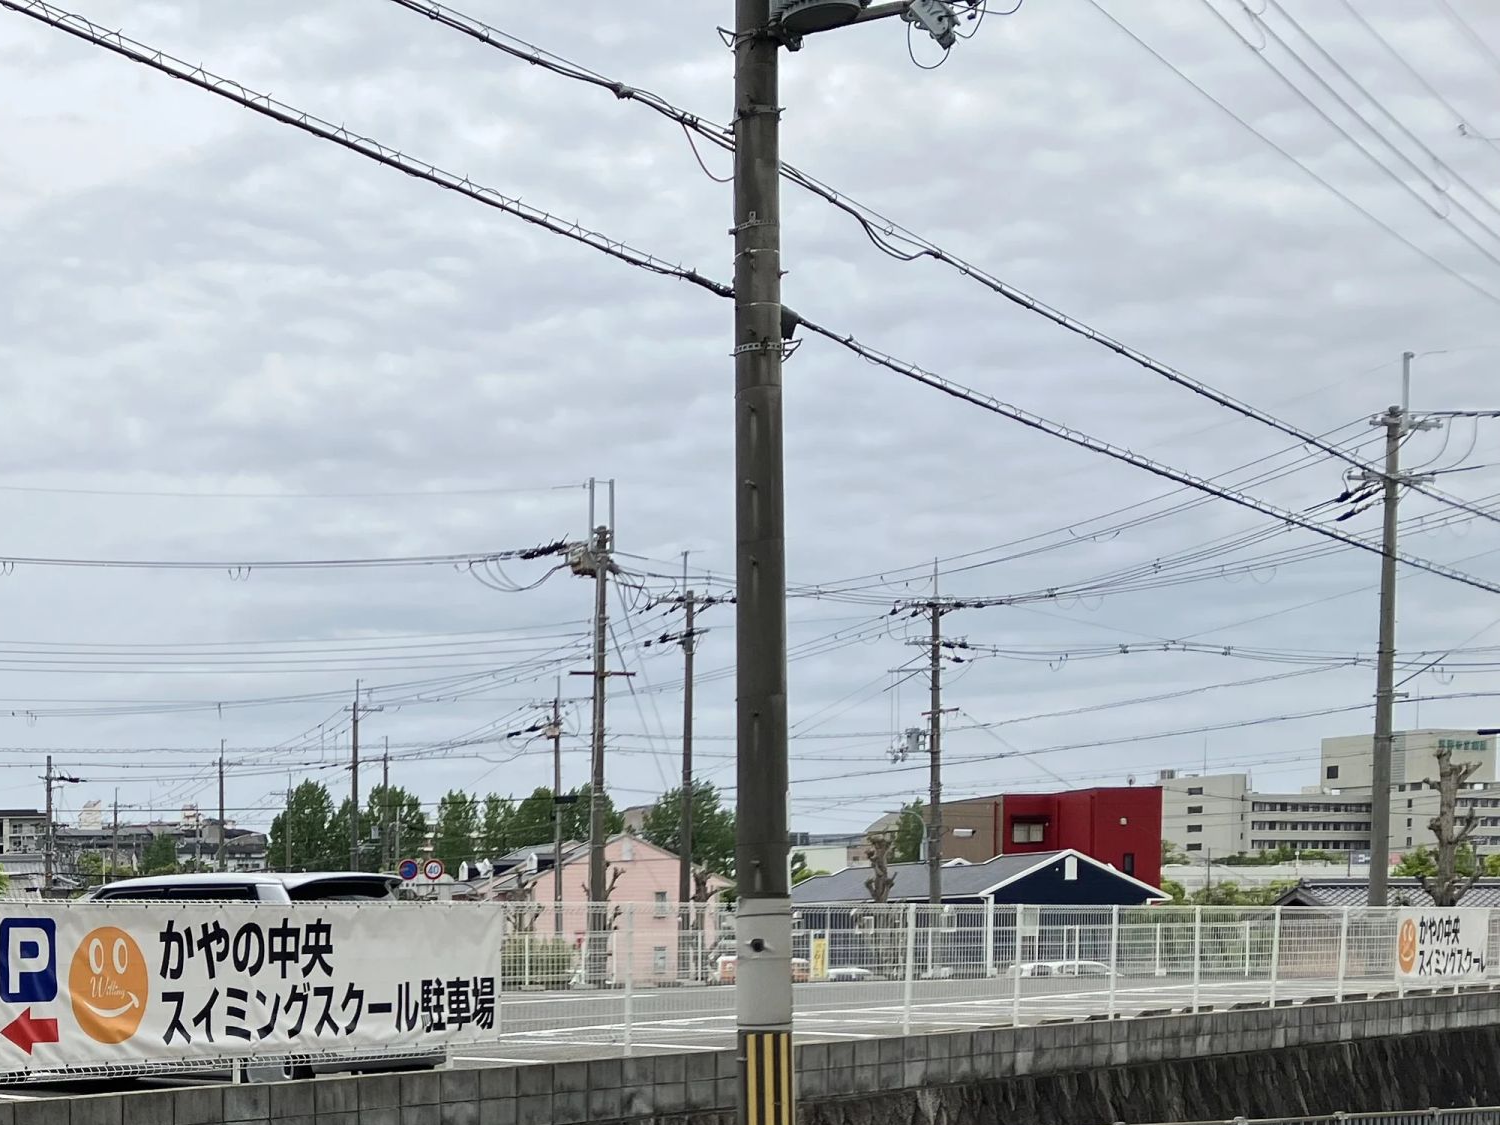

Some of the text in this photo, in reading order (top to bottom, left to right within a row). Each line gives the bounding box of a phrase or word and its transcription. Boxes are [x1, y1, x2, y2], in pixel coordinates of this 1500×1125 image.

[8, 926, 51, 995] P
[159, 917, 334, 980] かやの中央
[1418, 947, 1487, 976] スイミングスクール
[1419, 915, 1460, 945] かやの中央
[161, 975, 496, 1046] スイミングスクール駐車場
